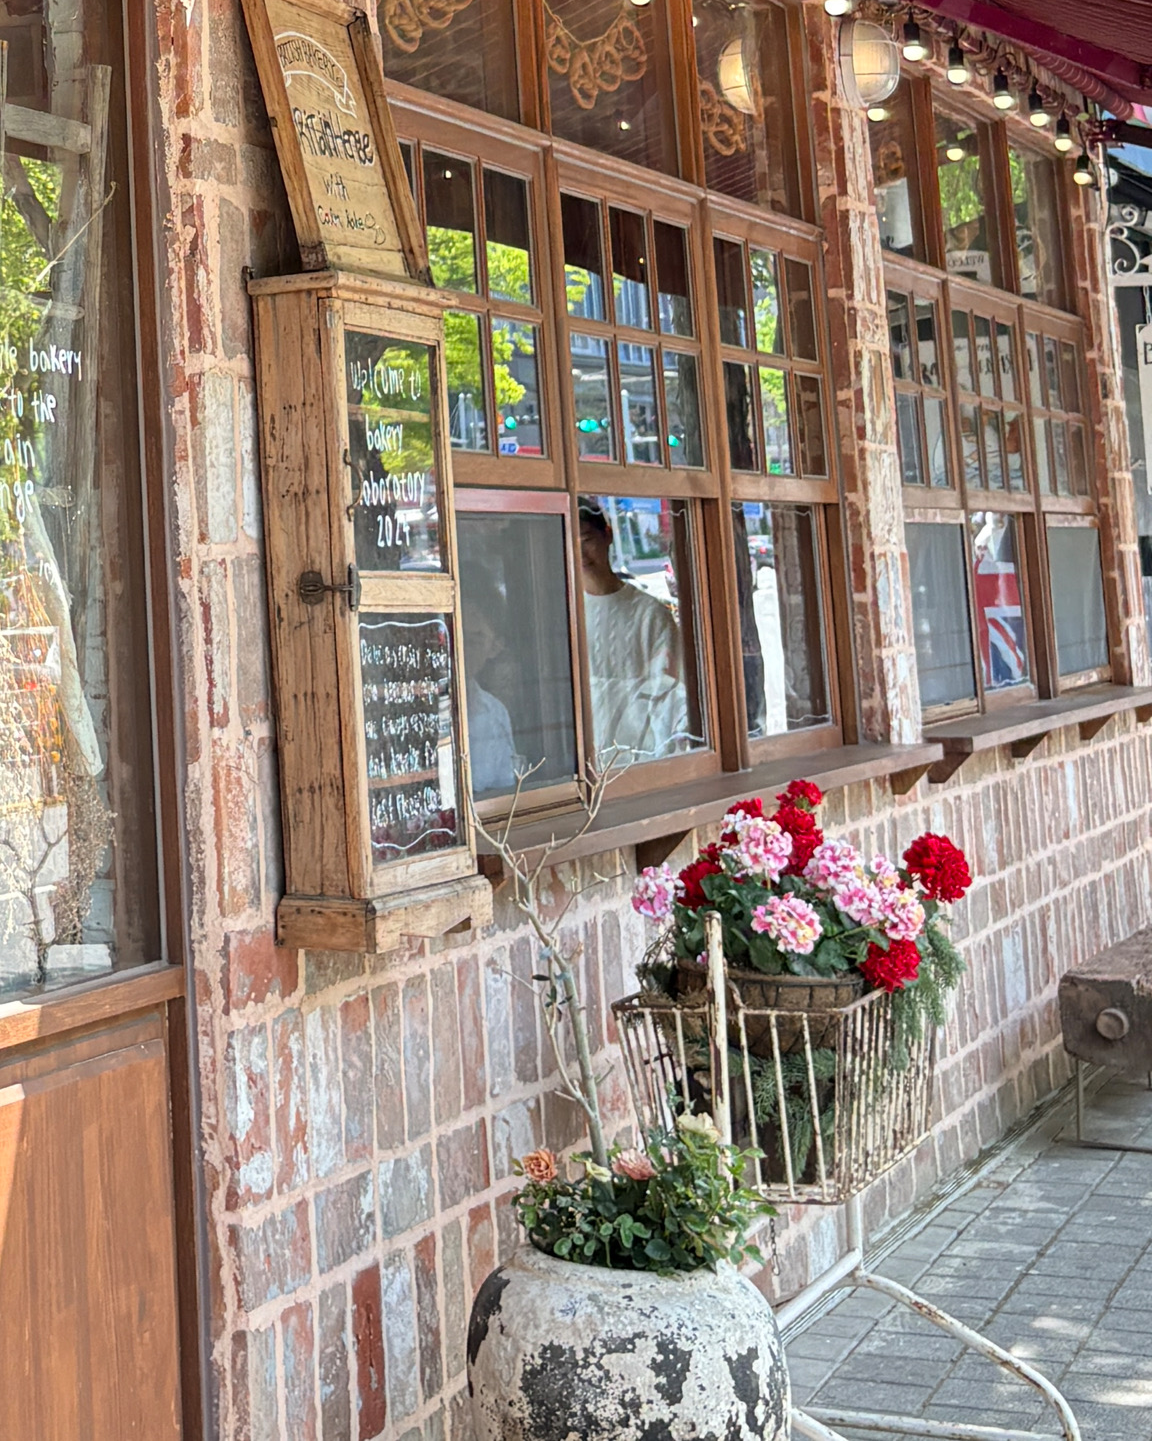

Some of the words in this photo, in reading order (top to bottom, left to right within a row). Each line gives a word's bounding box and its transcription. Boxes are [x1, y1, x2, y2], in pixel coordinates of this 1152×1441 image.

[29, 337, 83, 381] bakery
[409, 369, 422, 402] to
[31, 389, 57, 423] the
[365, 414, 404, 455] bakery
[360, 470, 425, 508] aboratory
[376, 514, 410, 548] 2024
